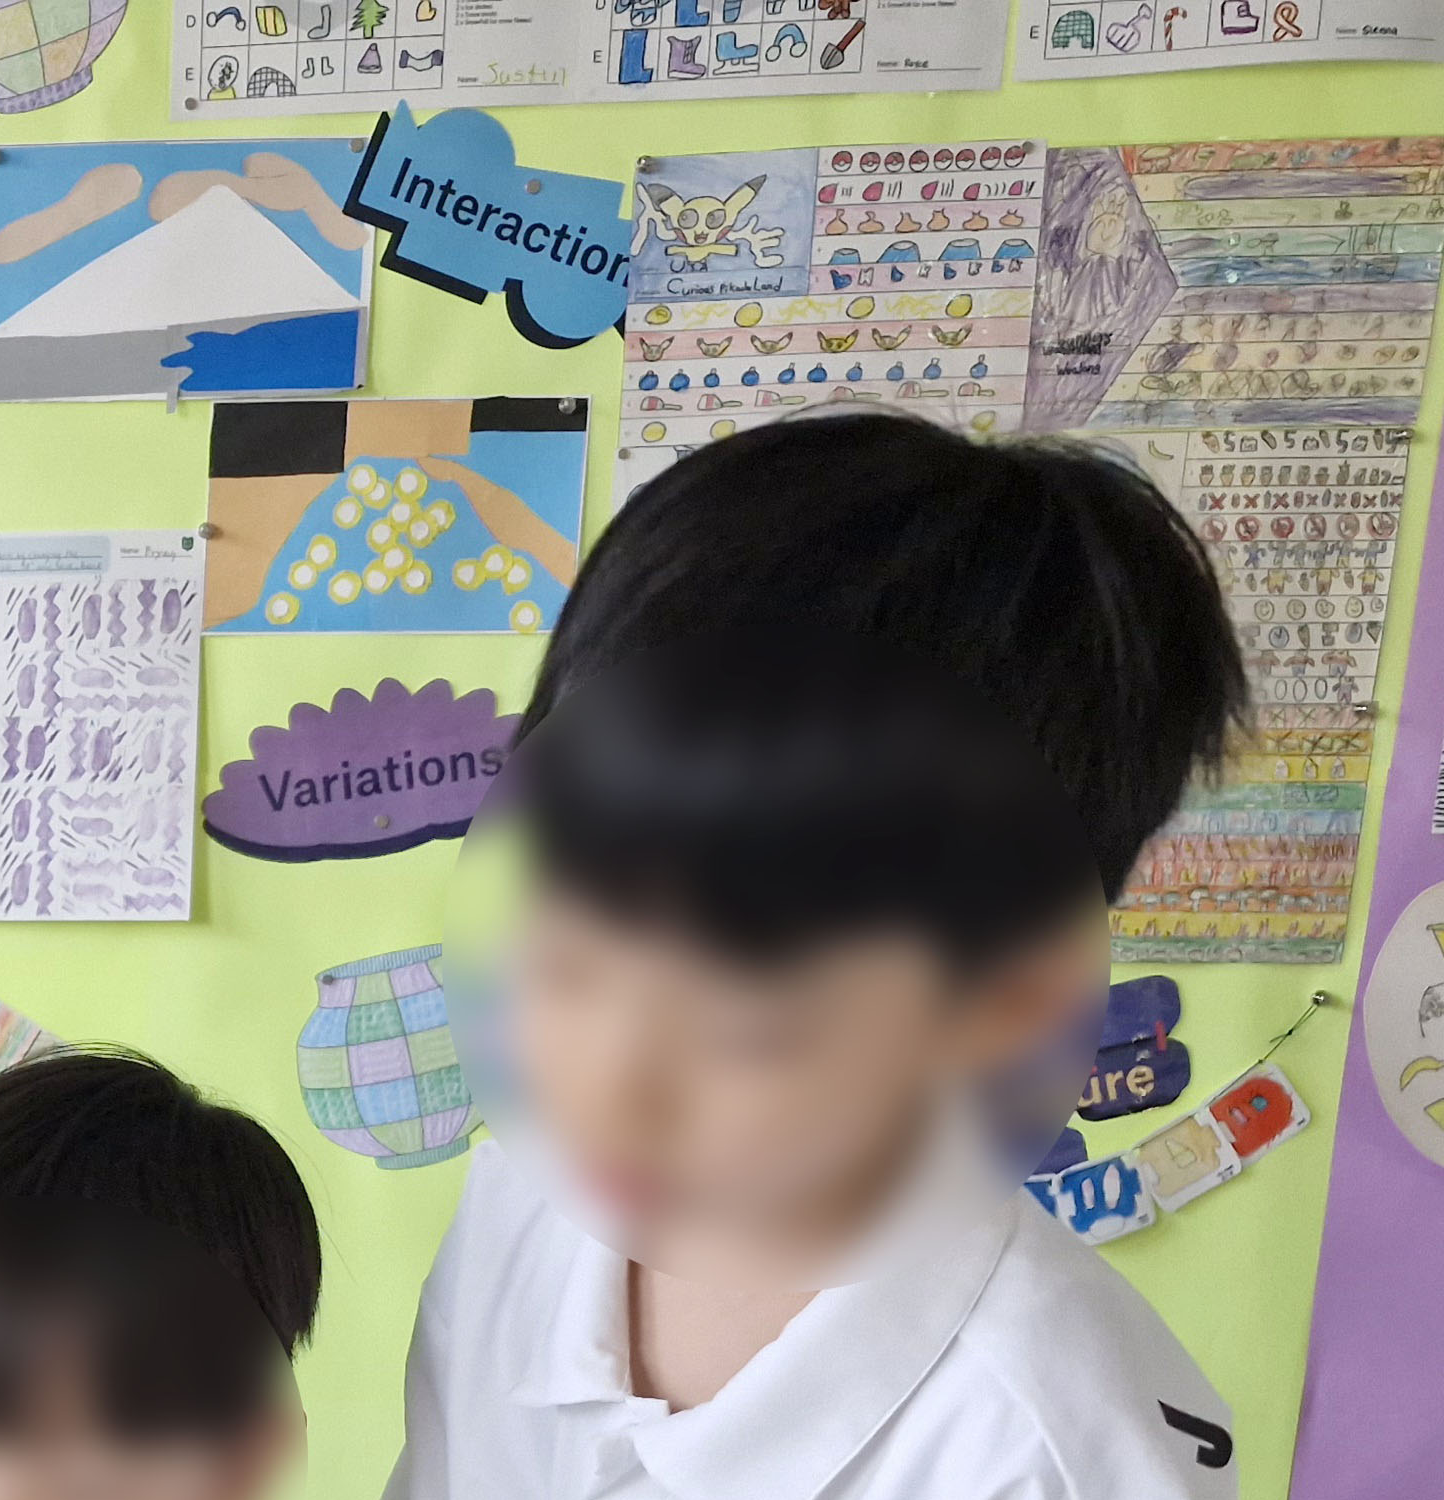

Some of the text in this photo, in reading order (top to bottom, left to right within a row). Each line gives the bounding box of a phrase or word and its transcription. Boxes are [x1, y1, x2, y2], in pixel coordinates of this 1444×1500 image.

[186, 15, 196, 28] D
[1030, 26, 1039, 39] E
[593, 50, 602, 64] E
[185, 67, 195, 81] E
[259, 748, 502, 813] Variations
[1157, 1399, 1233, 1469] J
